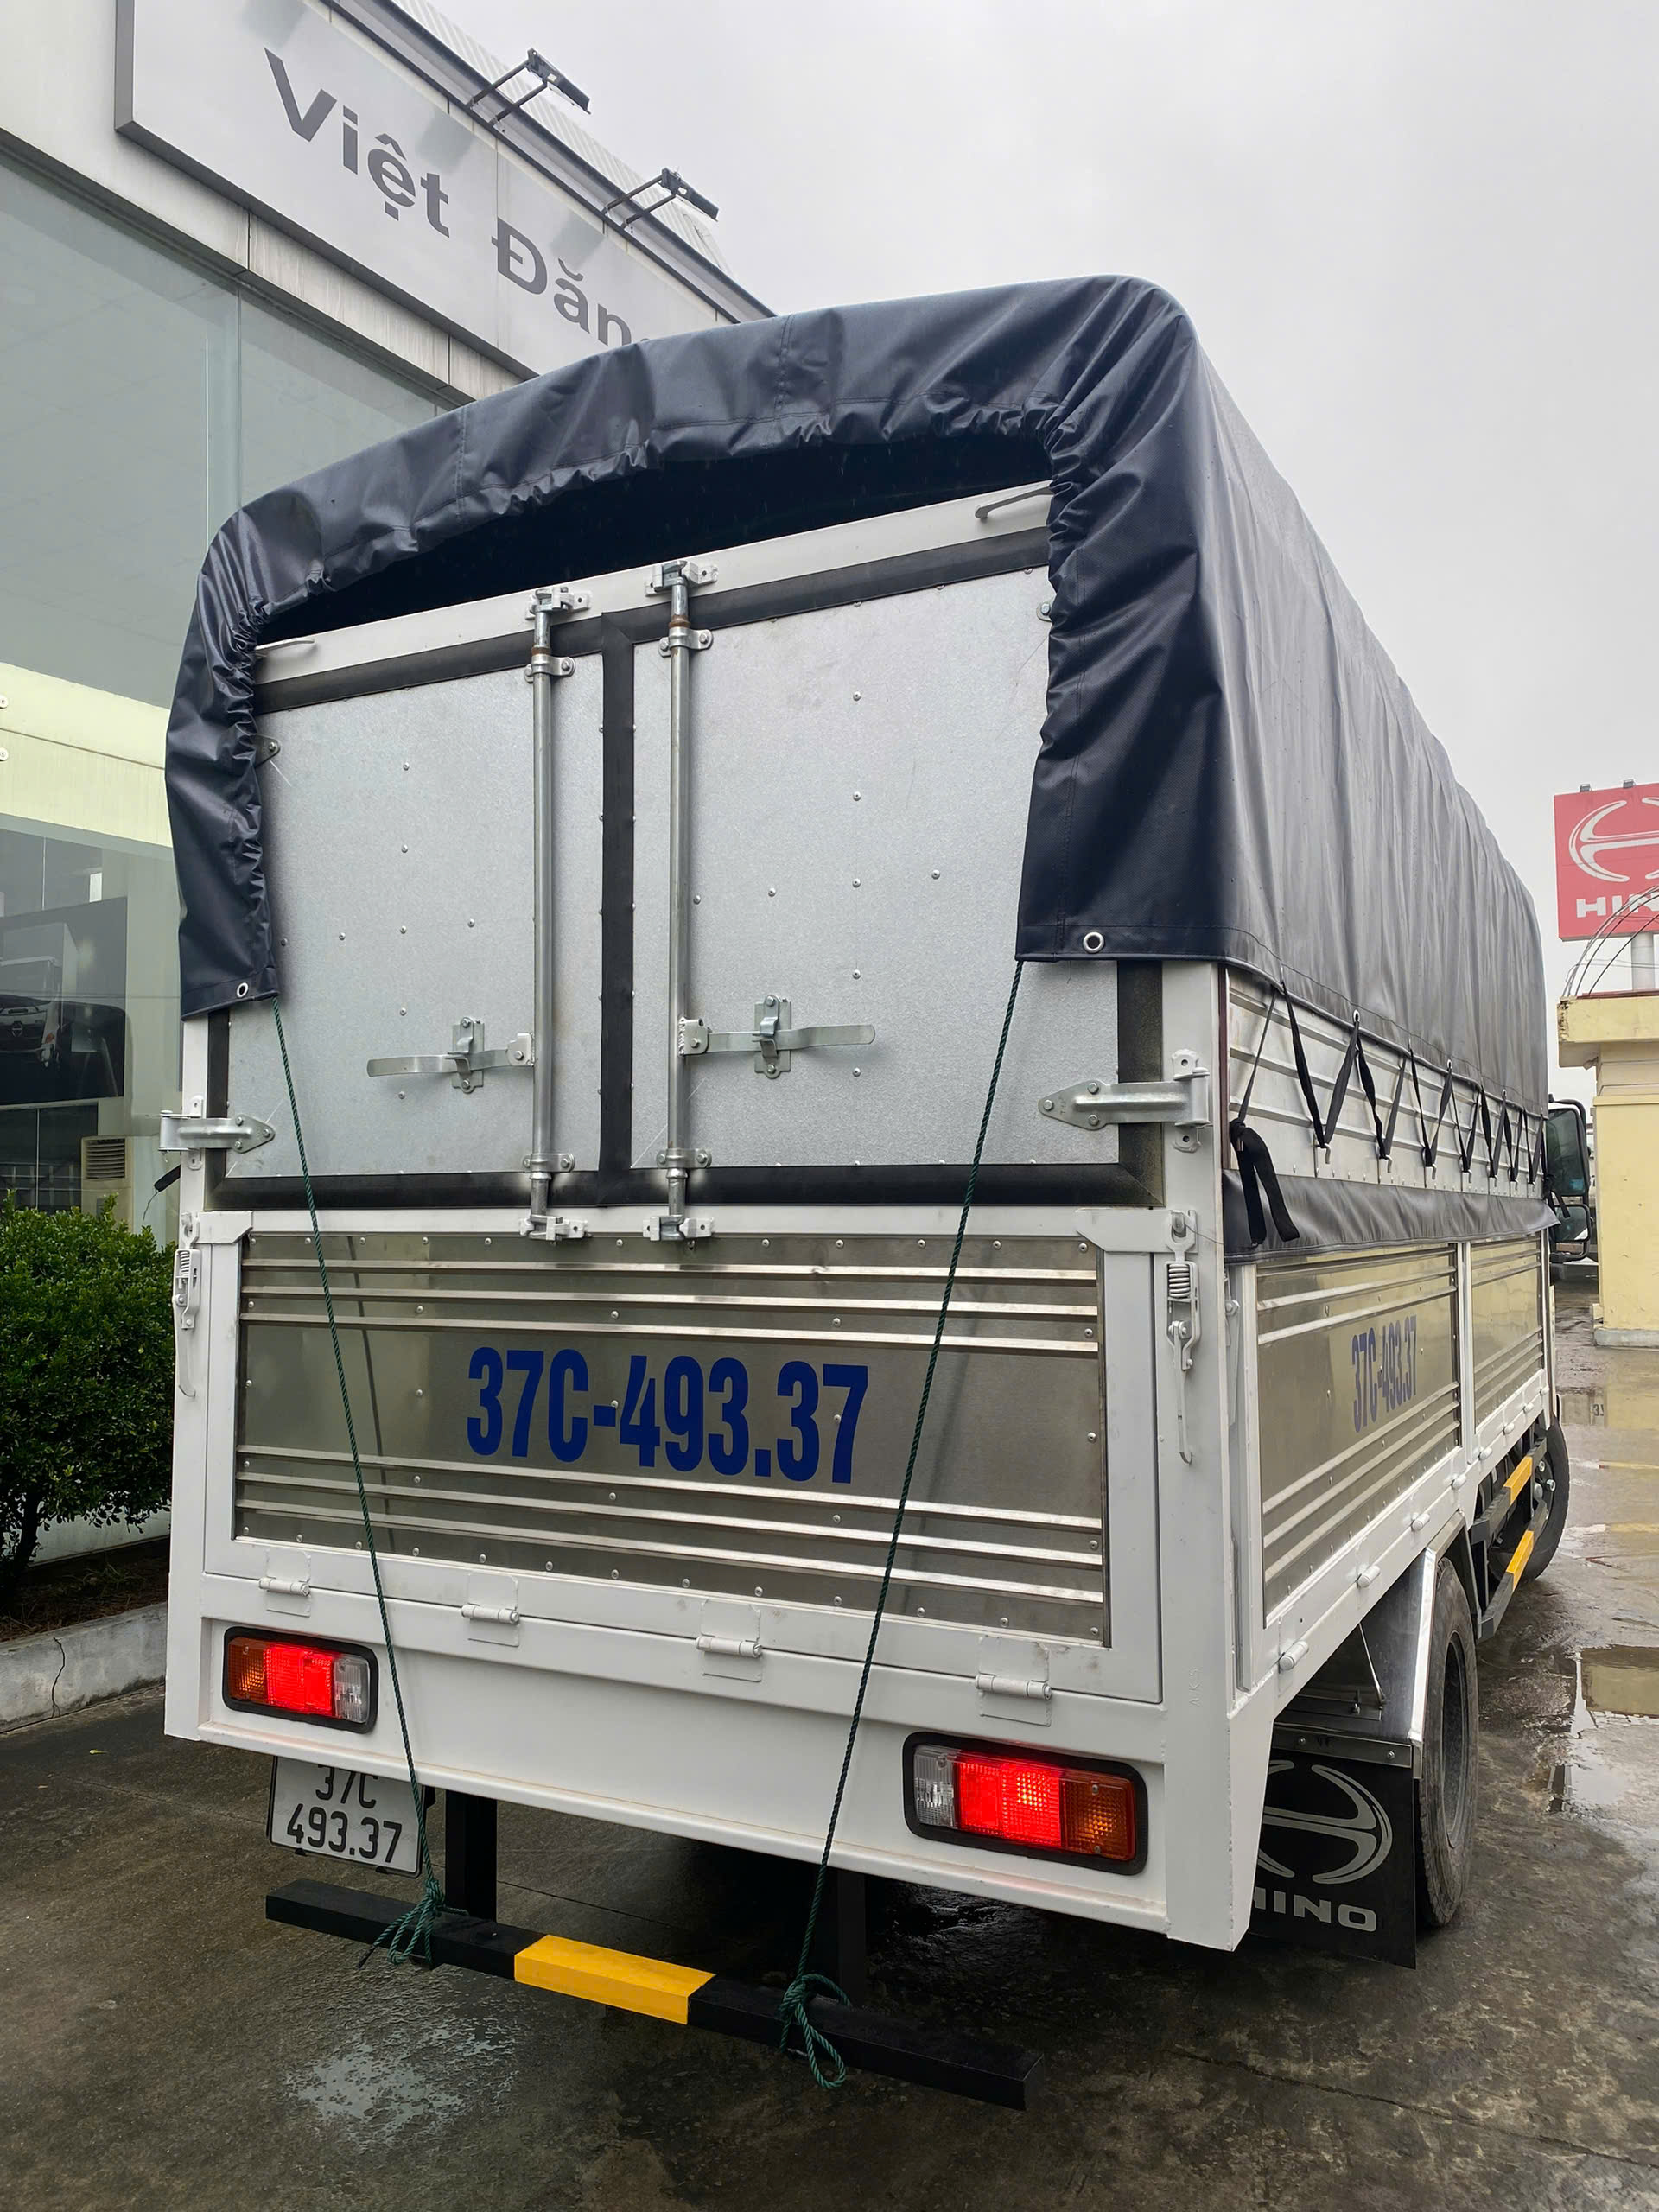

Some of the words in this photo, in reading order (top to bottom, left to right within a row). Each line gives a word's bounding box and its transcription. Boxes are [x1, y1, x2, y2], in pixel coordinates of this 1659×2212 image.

[264, 48, 450, 238] Việt
[492, 217, 650, 346] Đăn
[467, 1346, 868, 1484] 37C-493.37
[1351, 1314, 1416, 1433] 37C-493.37
[287, 1802, 402, 1863] 493.37
[315, 1764, 378, 1808] 37C
